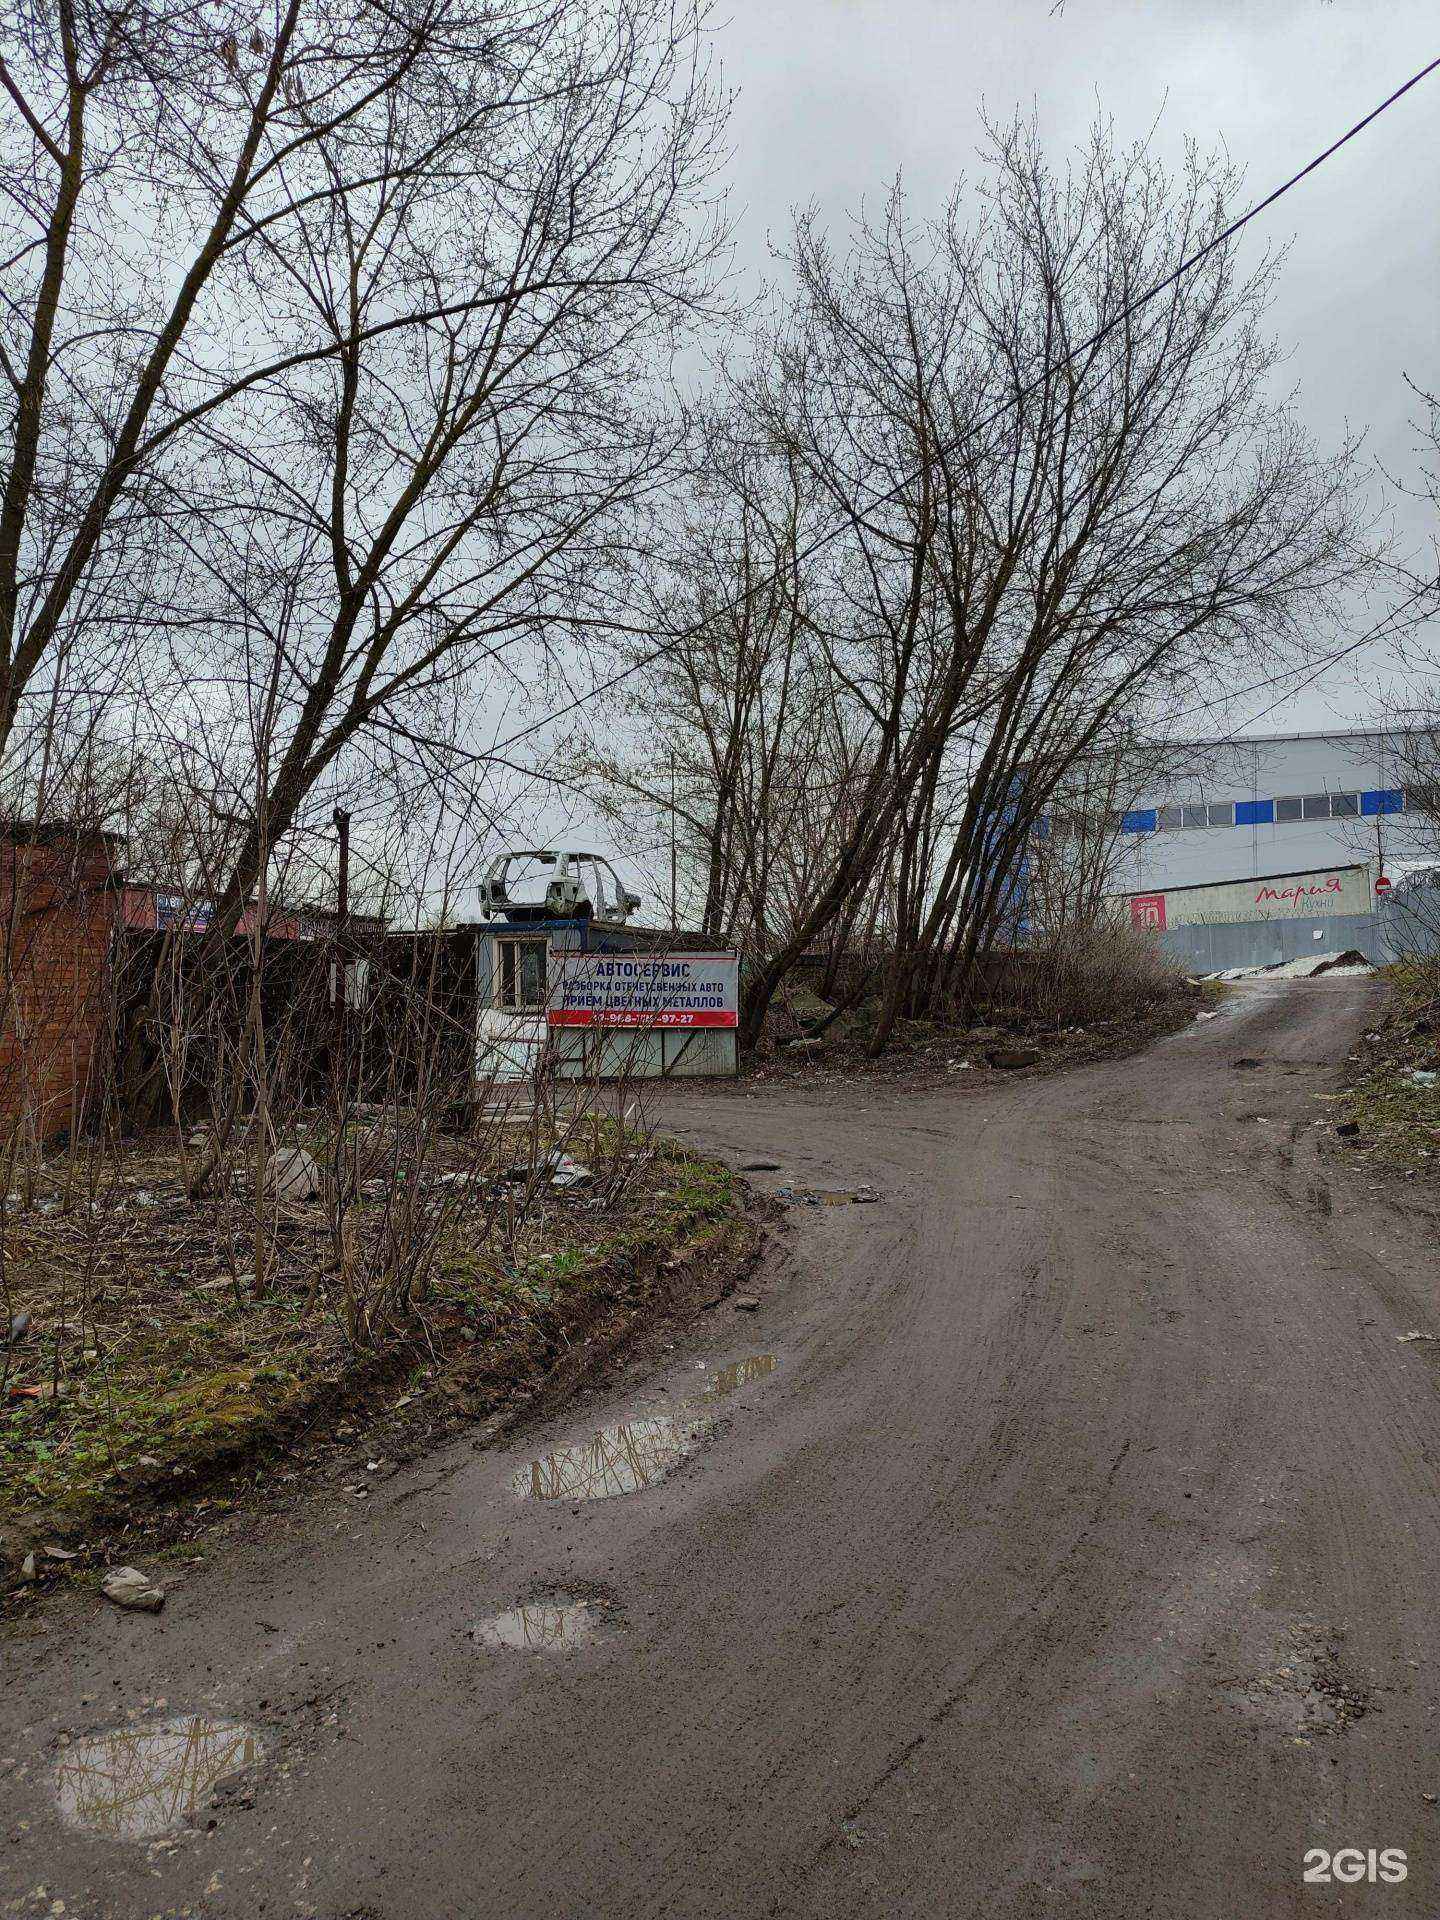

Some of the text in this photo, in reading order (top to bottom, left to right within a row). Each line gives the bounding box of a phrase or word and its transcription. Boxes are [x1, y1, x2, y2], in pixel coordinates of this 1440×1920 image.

[596, 962, 691, 978] АВТОСЕРВИС
[562, 981, 612, 991] РАЗБОРКА
[699, 982, 724, 993] АВТО
[605, 995, 659, 1008] ЦВЕТНЫХ
[662, 996, 724, 1008] МЕТАЛЛОВ
